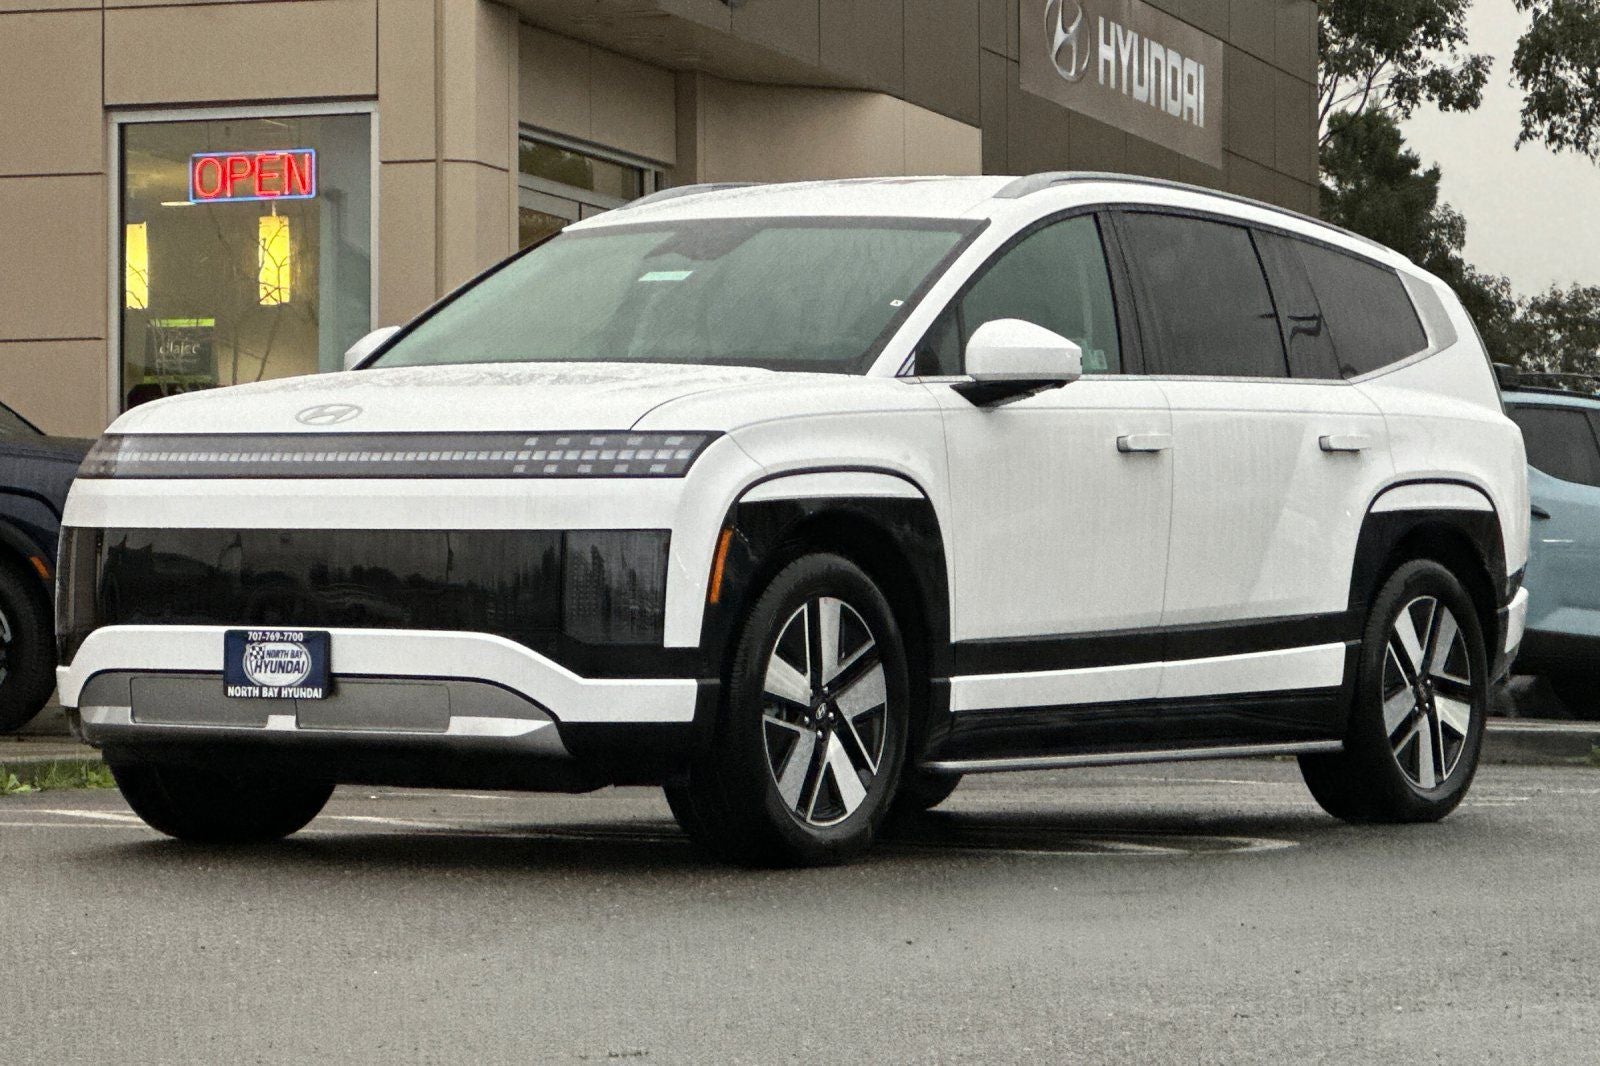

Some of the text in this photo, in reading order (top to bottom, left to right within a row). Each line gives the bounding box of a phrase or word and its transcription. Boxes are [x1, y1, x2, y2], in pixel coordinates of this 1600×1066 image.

[1098, 16, 1204, 128] HYUNDAI
[194, 153, 311, 198] OPEN
[247, 631, 304, 642] 707-769-7700
[266, 649, 303, 659] NORTH BAY
[254, 660, 305, 674] HYUNDAI
[227, 686, 322, 699] NORTH BAY HYUNDAI
